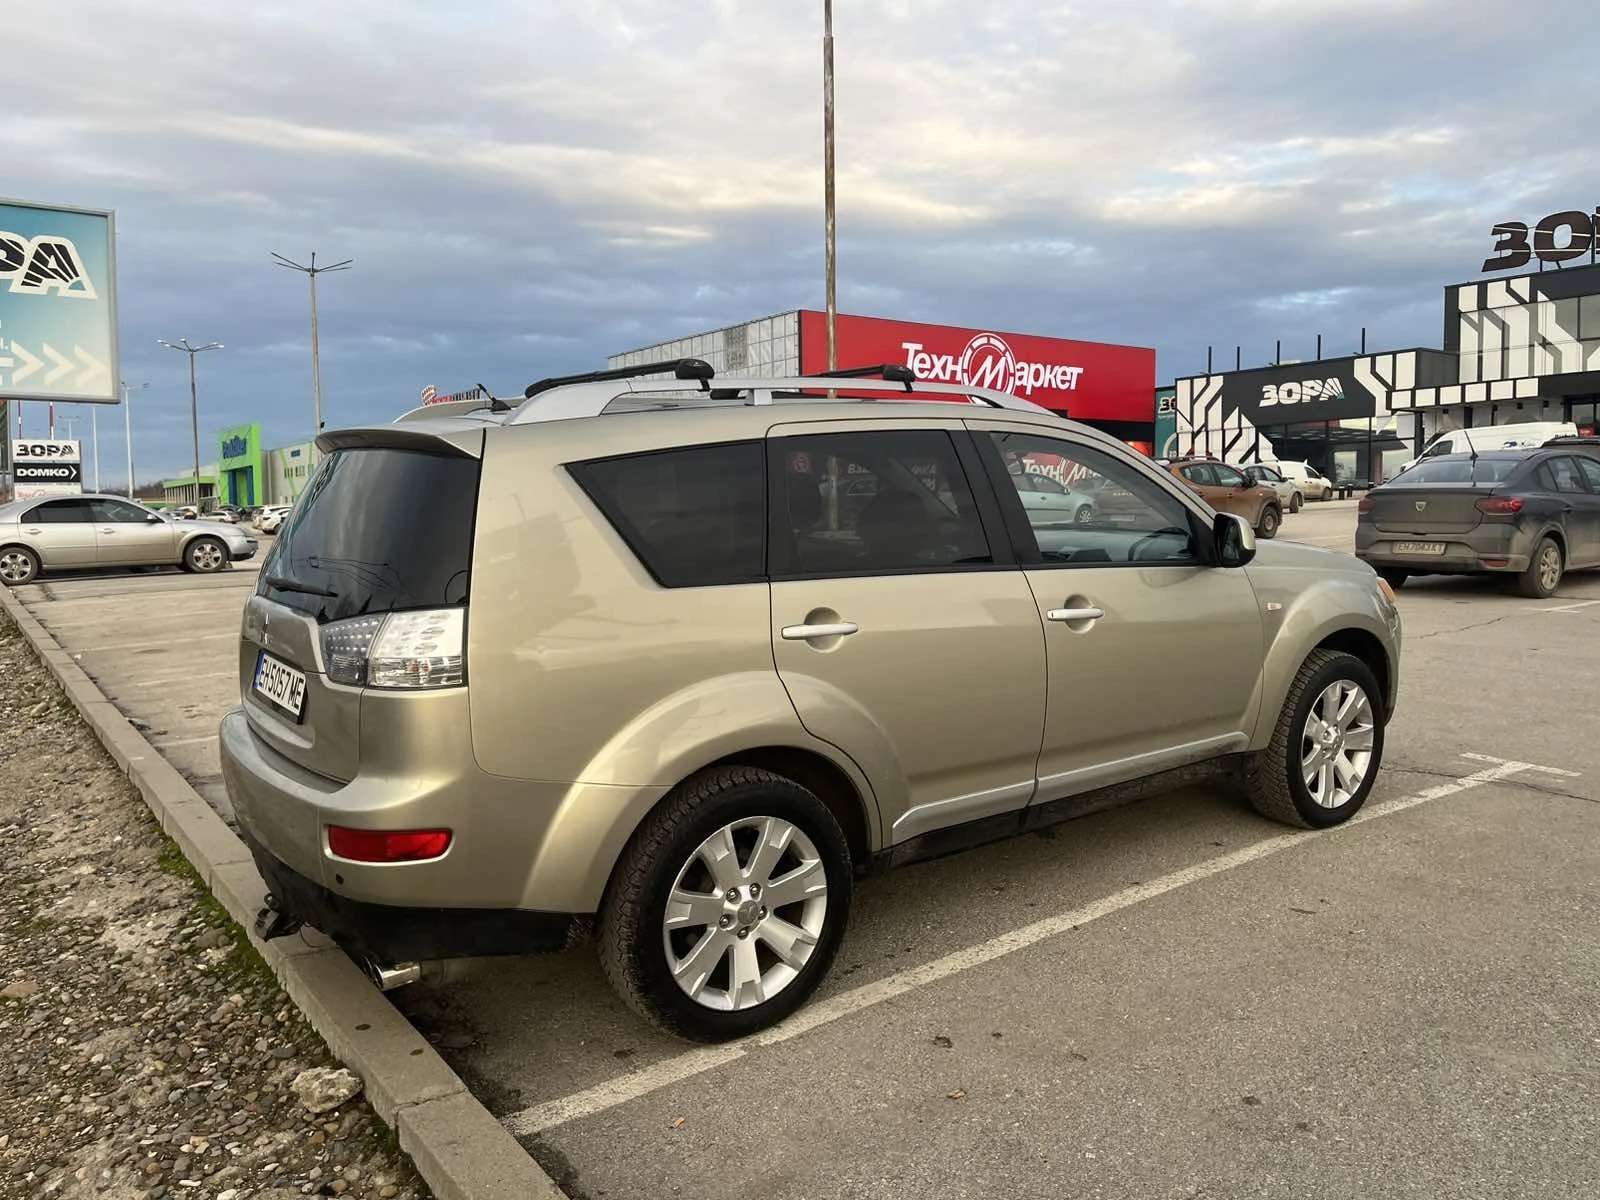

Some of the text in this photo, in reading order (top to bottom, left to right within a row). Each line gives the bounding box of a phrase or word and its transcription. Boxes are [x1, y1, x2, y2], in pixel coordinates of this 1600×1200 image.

[1482, 206, 1600, 272] ЗО
[1259, 377, 1344, 407] ЗОРА
[16, 444, 75, 457] ЗОРА
[16, 468, 69, 477] DOMKO
